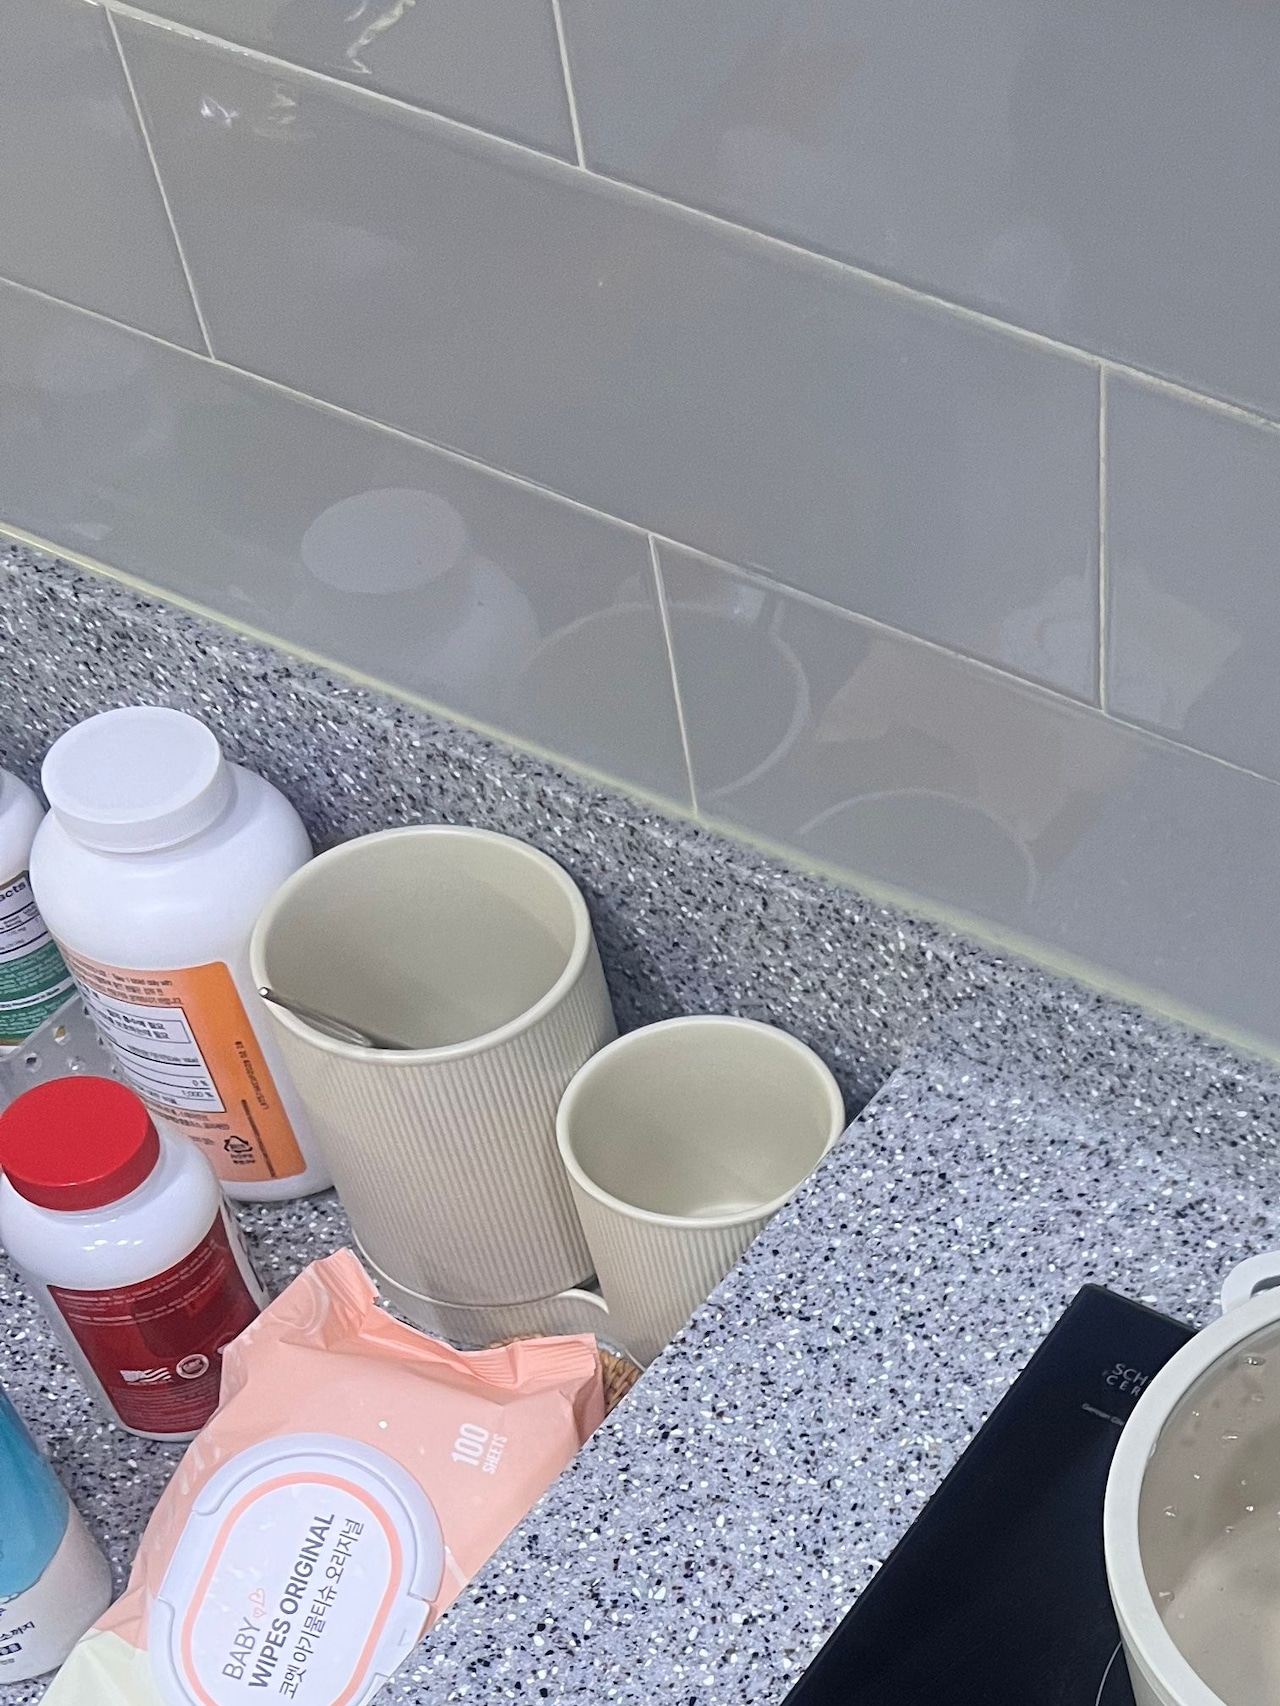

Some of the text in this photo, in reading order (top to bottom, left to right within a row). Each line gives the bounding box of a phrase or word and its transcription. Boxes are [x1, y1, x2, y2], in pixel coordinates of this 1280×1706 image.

[1112, 1363, 1150, 1386] SCH
[451, 1423, 489, 1466] 100
[482, 1433, 508, 1475] SHEETS
[248, 1514, 335, 1687] WIPES ORIGINAL
[279, 1518, 364, 1699] 코멧 아기물티슈 오리지널
[222, 1617, 260, 1680] BABY
